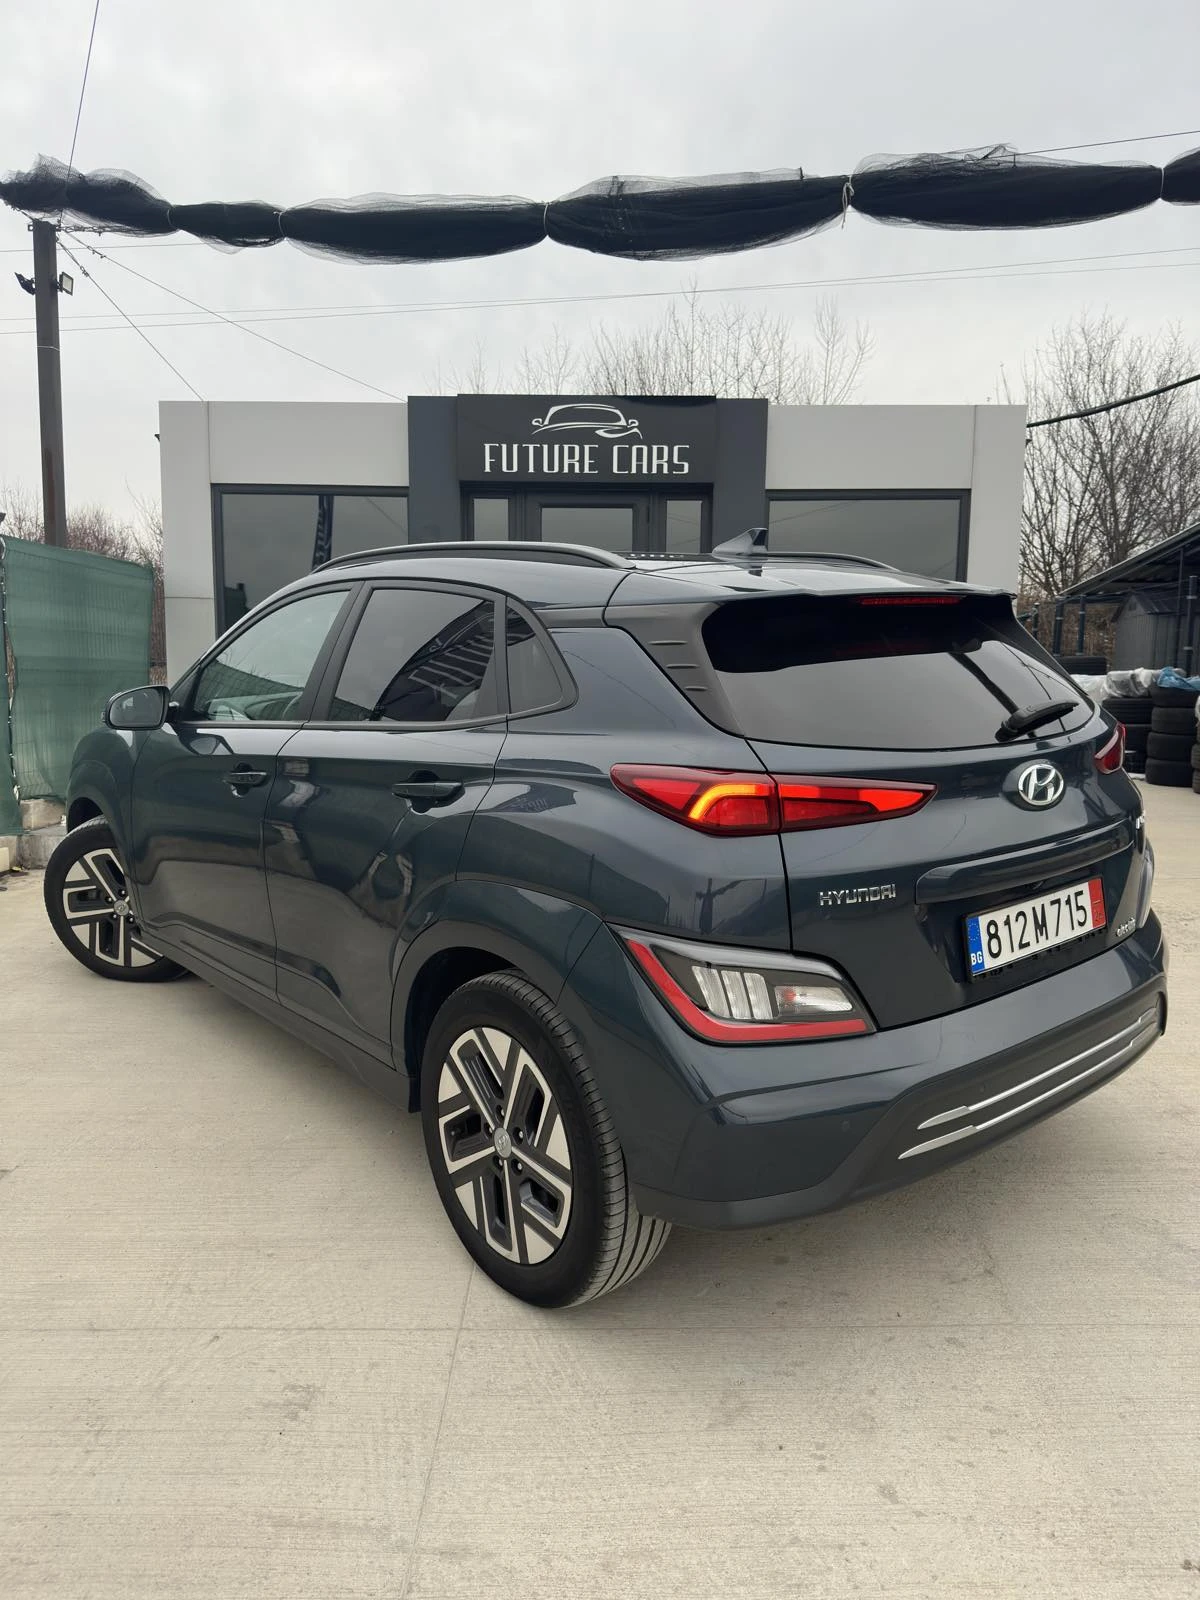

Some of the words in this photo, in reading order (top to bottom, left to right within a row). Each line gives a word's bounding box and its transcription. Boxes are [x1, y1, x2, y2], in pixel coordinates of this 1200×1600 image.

[483, 443, 599, 474] FUTURE
[612, 444, 690, 475] CARS
[819, 883, 897, 906] HYUNDAI
[986, 890, 1088, 959] 812M715
[970, 951, 984, 966] BG
